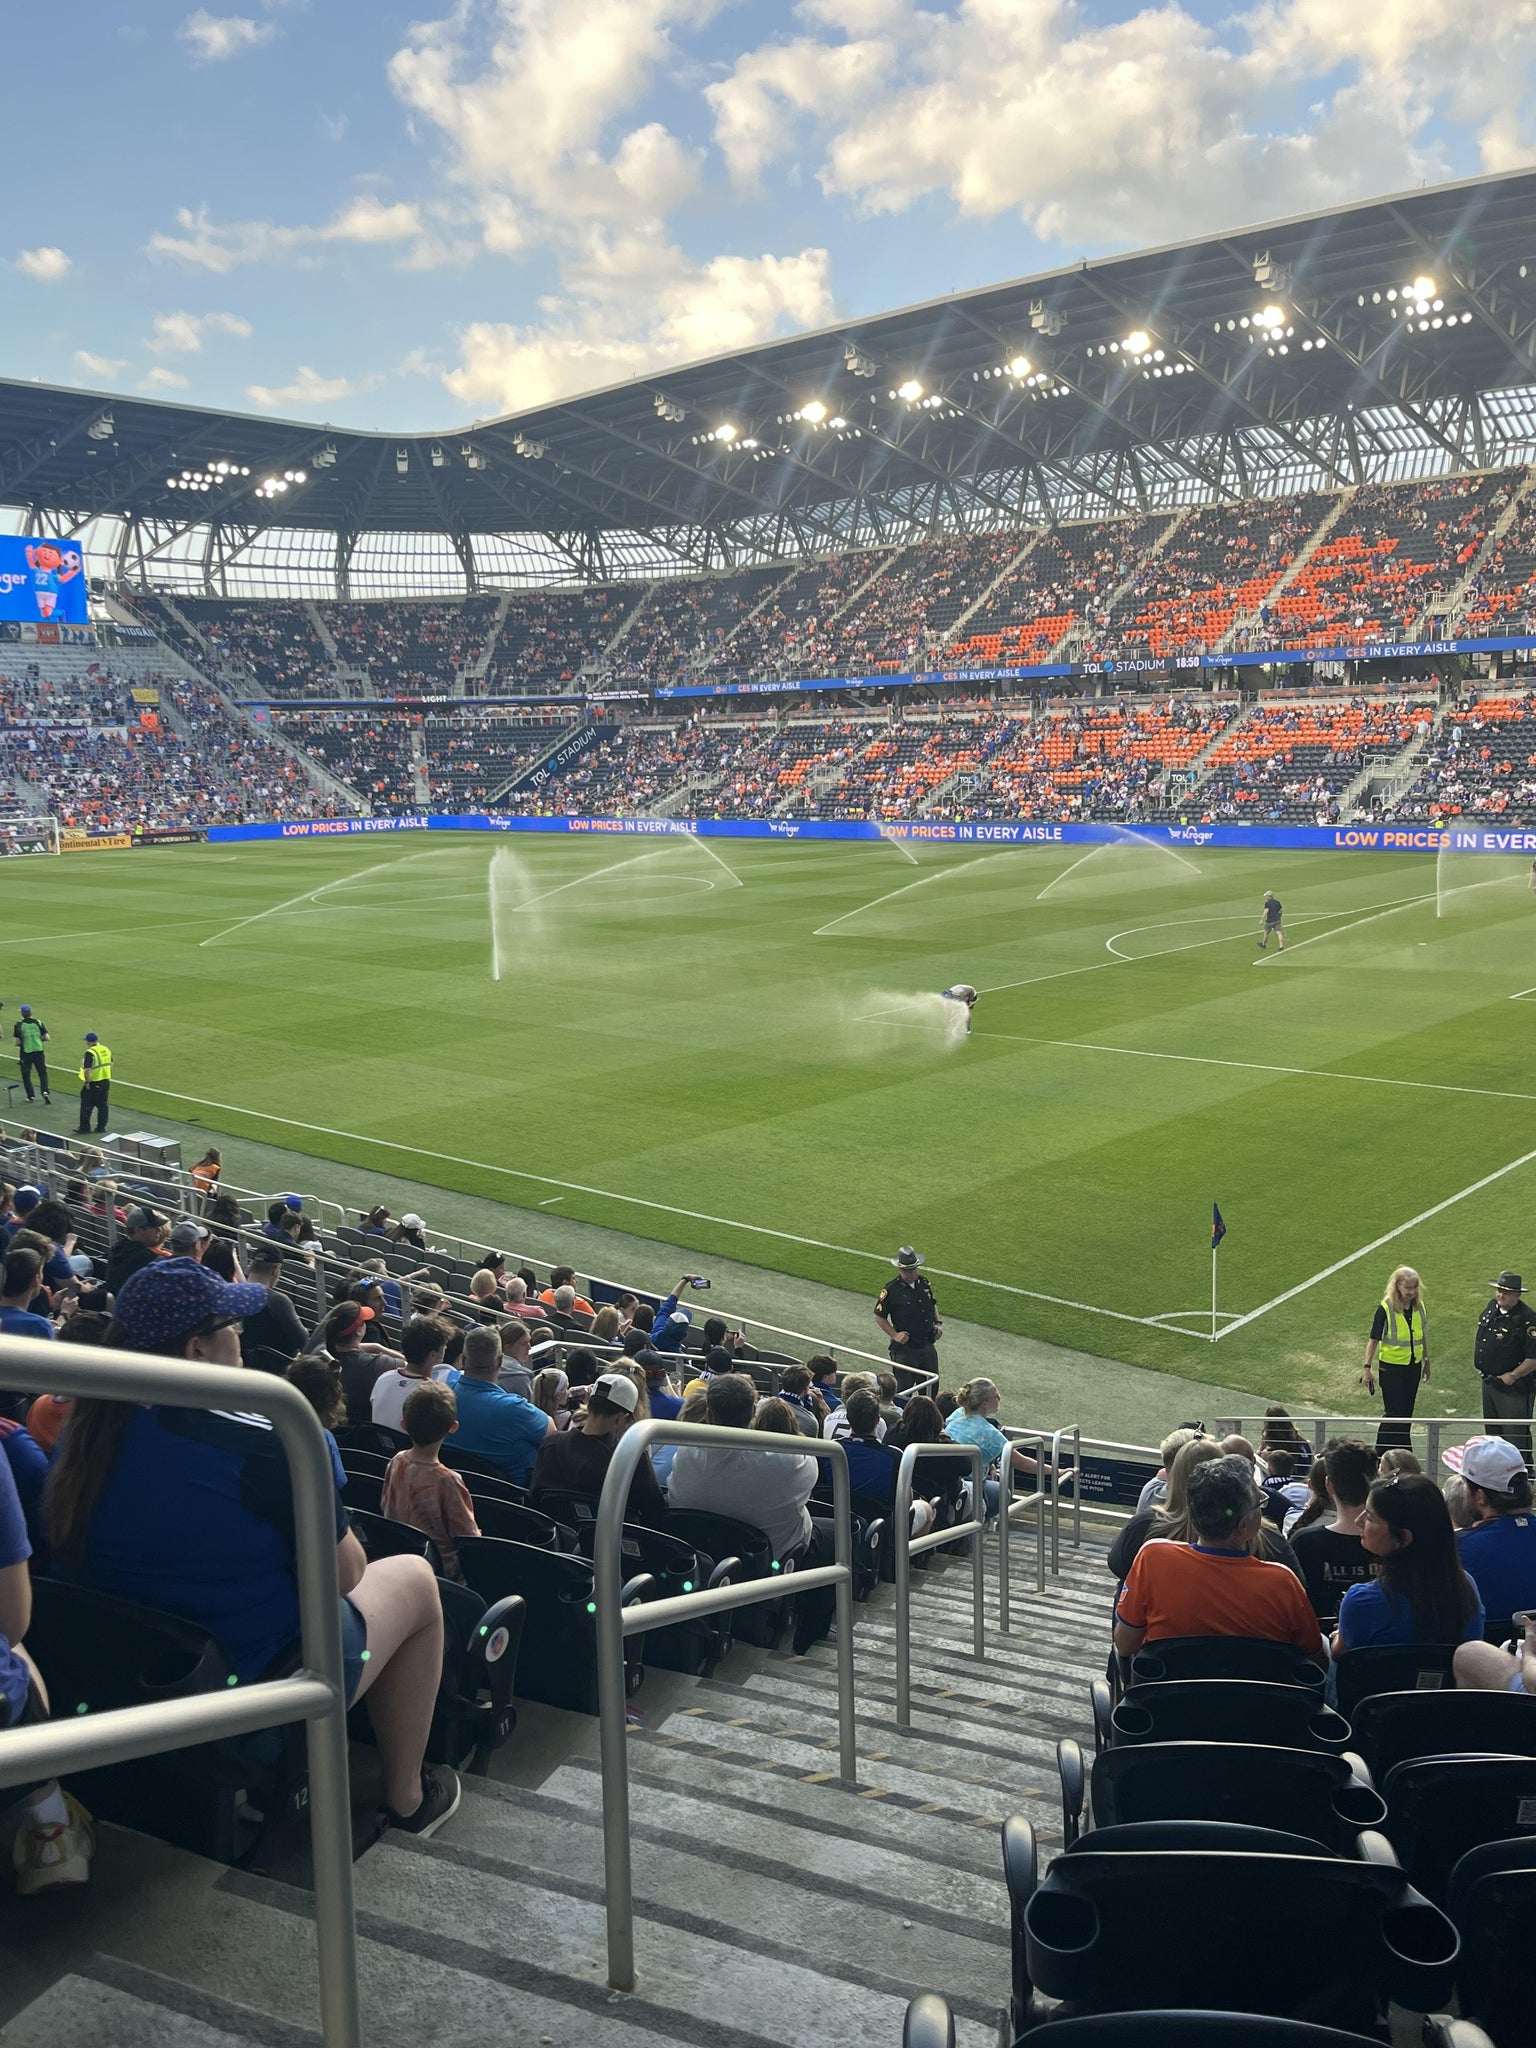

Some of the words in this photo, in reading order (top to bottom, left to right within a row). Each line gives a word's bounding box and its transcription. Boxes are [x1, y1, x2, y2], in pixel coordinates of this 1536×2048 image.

[35, 573, 48, 585] 22
[1370, 647, 1381, 657] IN
[1384, 646, 1422, 657] EVERY
[1424, 642, 1457, 653] AISLE
[1083, 663, 1103, 674] TQL
[1116, 659, 1165, 672] STADIUM
[1176, 656, 1200, 668] 18:50
[959, 671, 968, 680] IN
[969, 670, 995, 680] EVERY
[997, 668, 1020, 678] AISLE
[751, 683, 759, 691] IN
[760, 682, 781, 692] EVERY
[781, 681, 801, 690] AISLE
[422, 695, 448, 703] LIGHT
[529, 768, 551, 787] TQL
[556, 727, 597, 765] STADIUM
[959, 776, 972, 784] TQL
[1171, 774, 1187, 783] TQL
[282, 826, 310, 836] LOW
[312, 822, 349, 834] PRICES
[351, 821, 362, 831] IN
[365, 819, 397, 830] EVERY
[399, 817, 428, 828] AISLE
[569, 820, 590, 830] LOW
[591, 820, 623, 831] PRICES
[625, 821, 635, 831] IN
[637, 821, 668, 832] EVERY
[670, 821, 697, 833] AISLE
[880, 825, 909, 837] LOW
[912, 826, 956, 838] PRICES
[959, 826, 973, 838] IN
[976, 826, 1020, 839] EVERY
[1022, 827, 1062, 840] AISLE
[1182, 825, 1214, 845] Kroger
[1335, 831, 1379, 847] LOW
[1383, 832, 1451, 847] PRICES
[1456, 833, 1475, 848] IN
[108, 837, 126, 846] Tire
